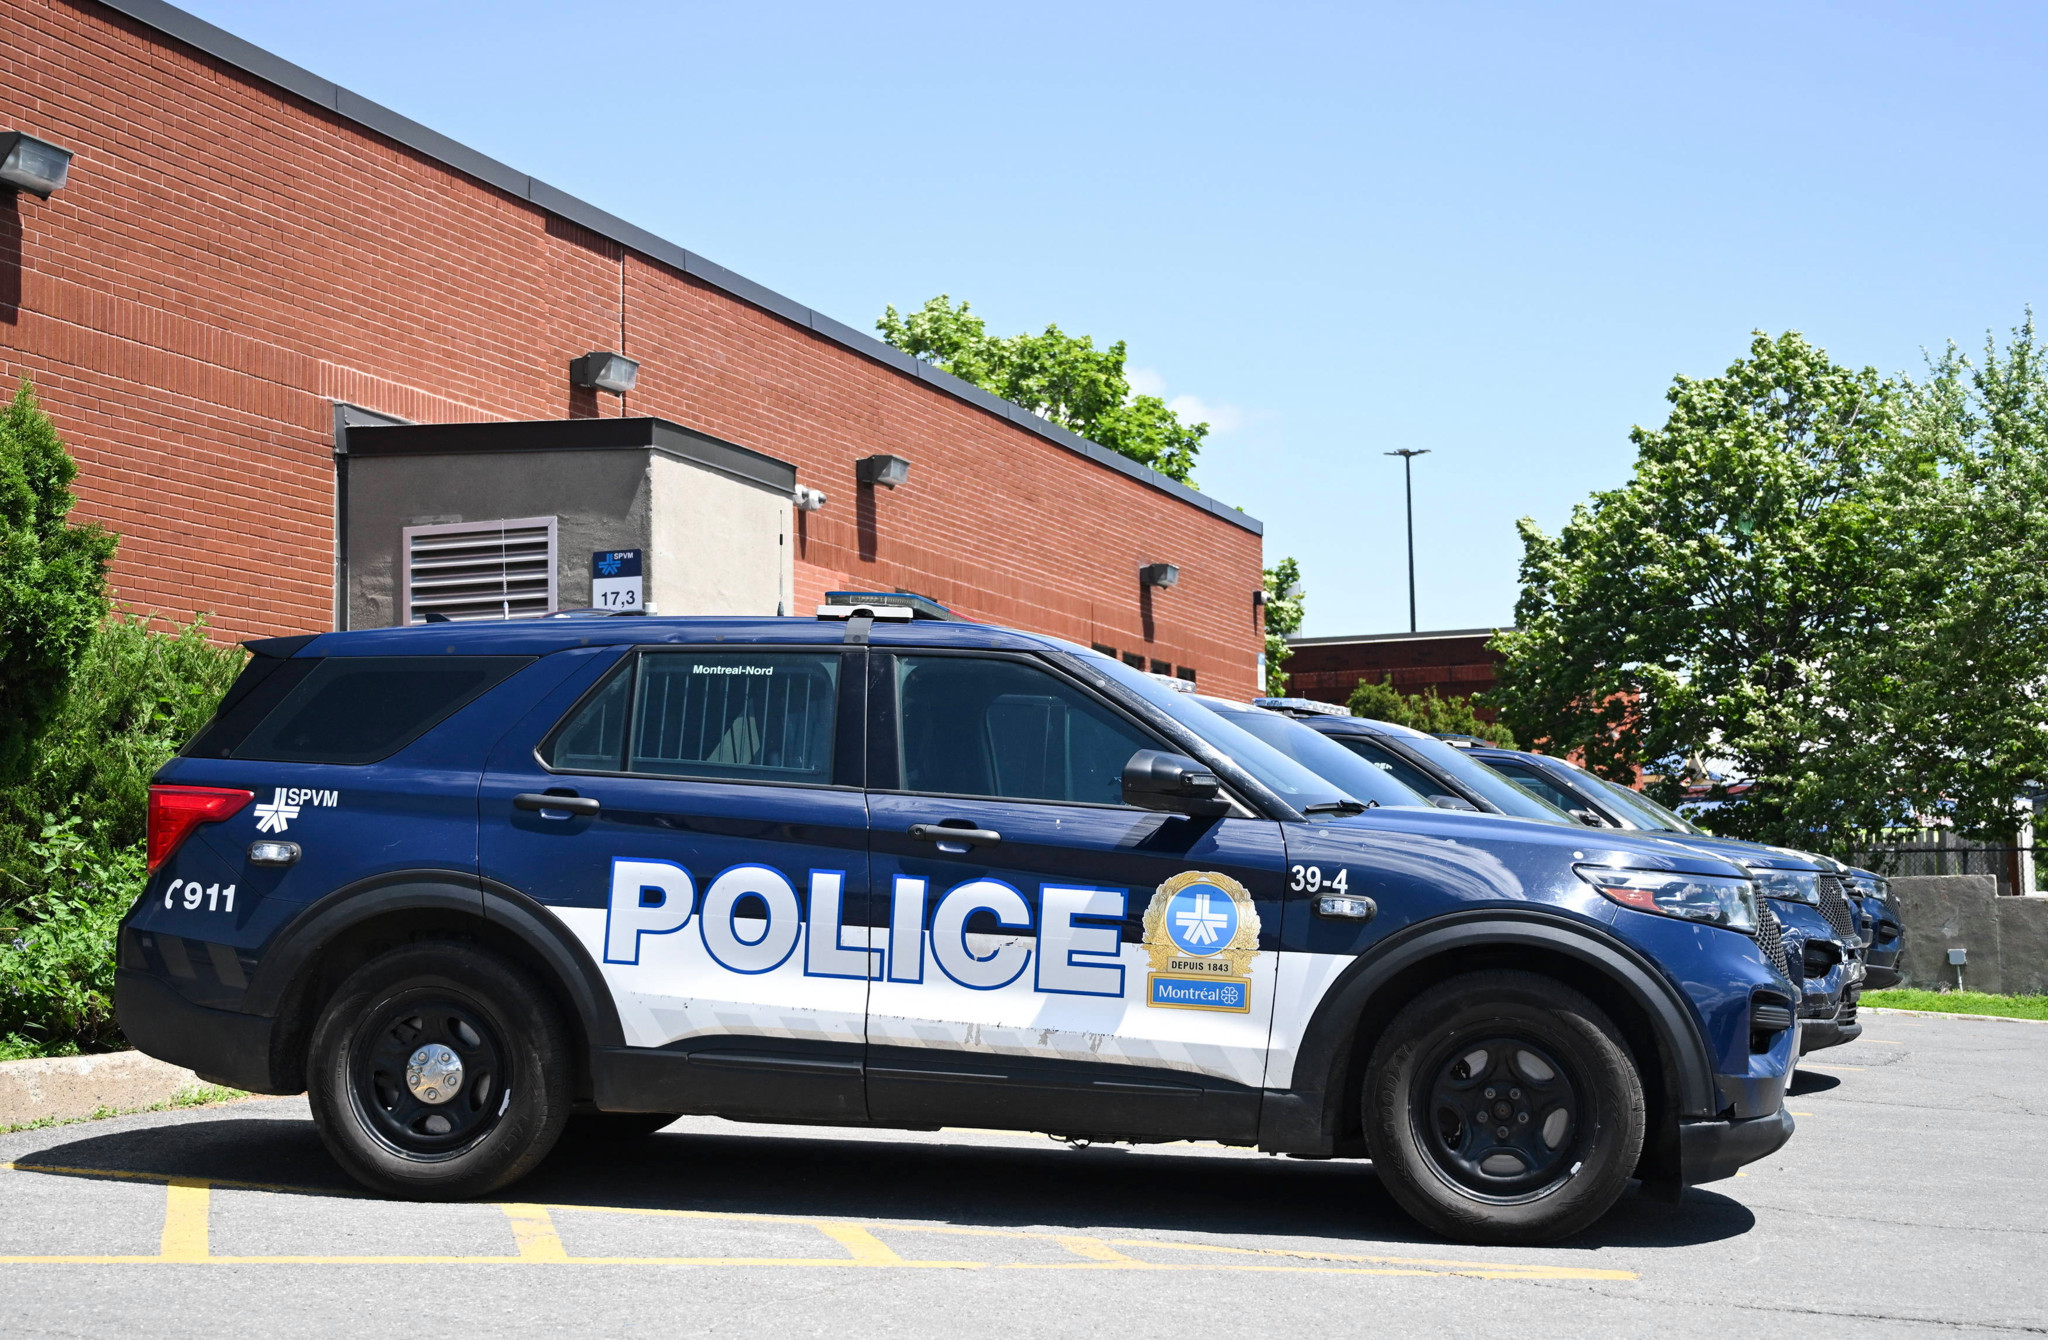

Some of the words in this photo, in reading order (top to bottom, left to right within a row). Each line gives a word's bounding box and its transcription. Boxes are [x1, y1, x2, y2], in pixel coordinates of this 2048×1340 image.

[601, 590, 635, 608] 17,3
[692, 664, 774, 675] Montreal-Nord
[287, 788, 339, 807] SPVM
[1290, 865, 1348, 894] 39-4
[182, 881, 236, 912] 911
[603, 856, 1129, 998] POLICE
[1171, 960, 1204, 971] DEPUIS
[1207, 963, 1229, 972] 1843
[1159, 984, 1219, 1001] Montréal
